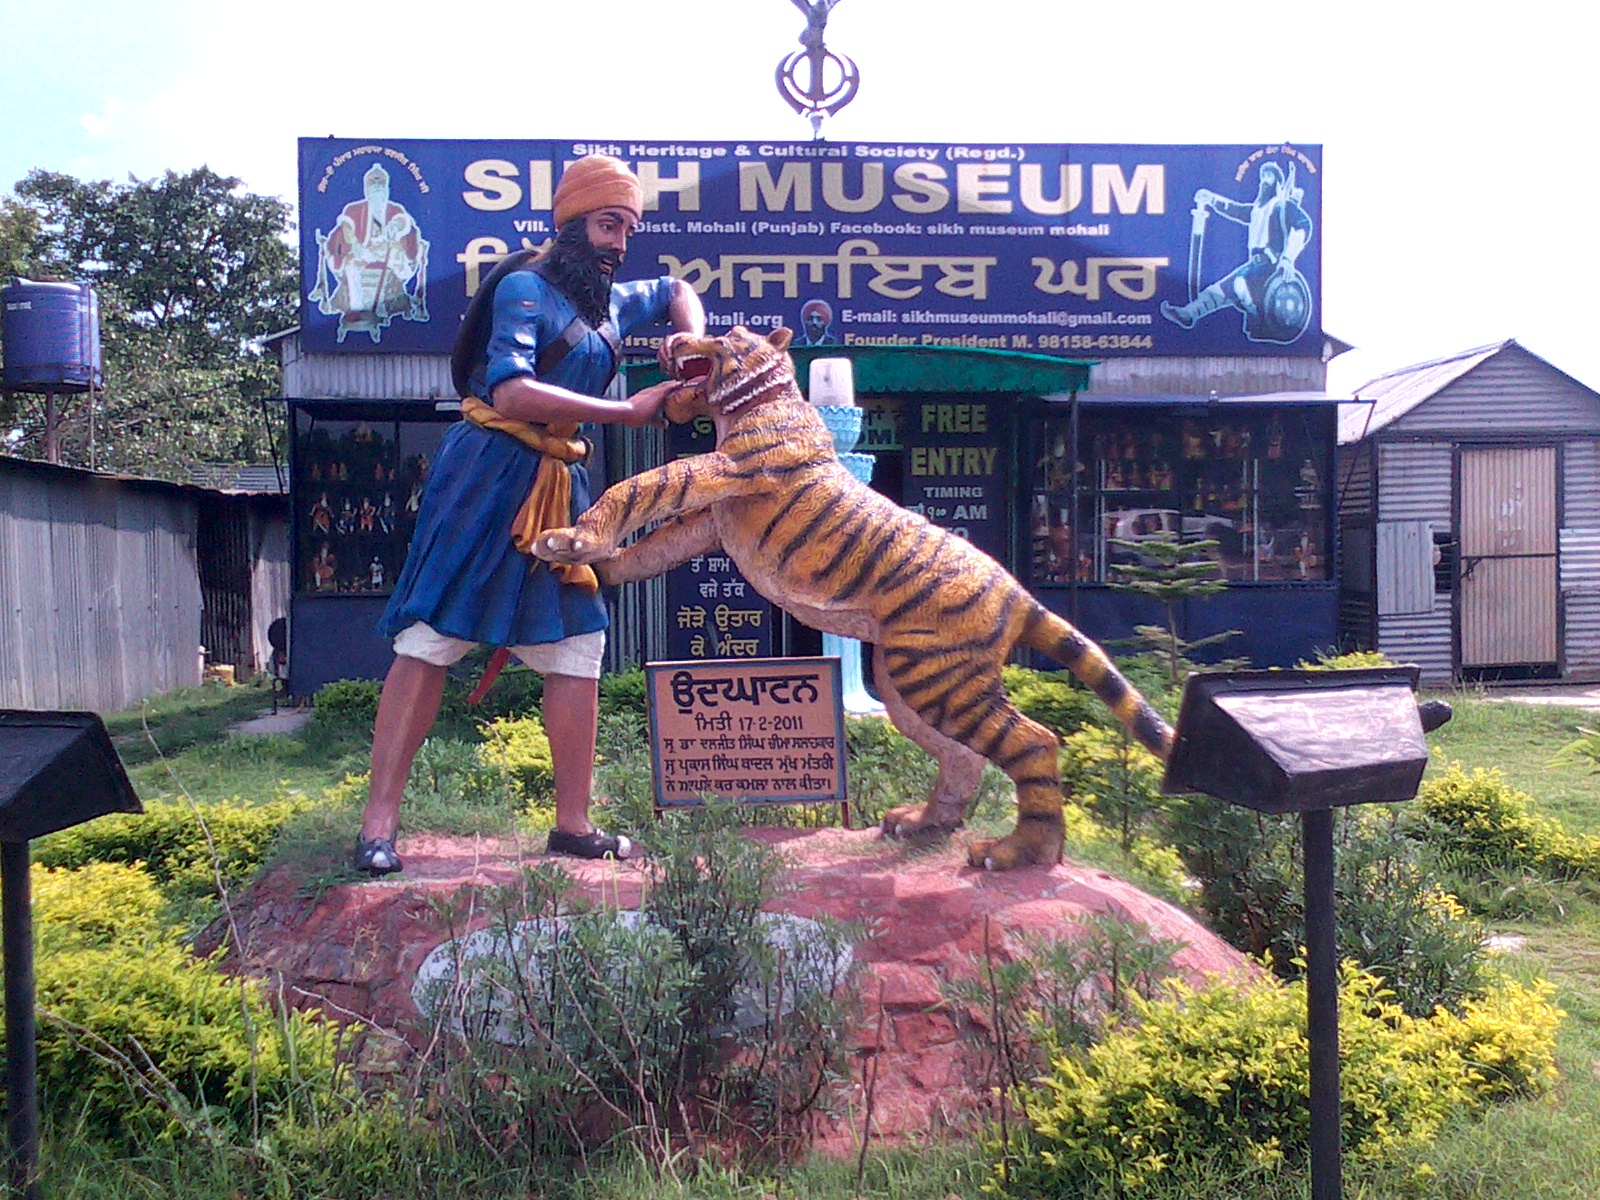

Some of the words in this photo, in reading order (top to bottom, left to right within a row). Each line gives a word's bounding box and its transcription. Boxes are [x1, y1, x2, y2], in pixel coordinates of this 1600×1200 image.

[572, 143, 622, 156] Sikh
[629, 144, 727, 159] Heritage
[734, 145, 751, 156] &
[758, 145, 848, 157] Cultural
[855, 146, 940, 159] Society
[945, 146, 1026, 160] (Regd.)
[463, 159, 700, 212] SIH
[738, 161, 1165, 215] MUSEUM
[513, 220, 549, 233] Vill.
[636, 222, 682, 234] Distt.
[687, 222, 747, 234] Mohali
[751, 222, 825, 236] (Punjab)
[831, 222, 922, 235] Facebook:
[927, 223, 964, 235] sikh
[970, 226, 1044, 236] museum
[1050, 224, 1110, 236] mohali
[1031, 257, 1170, 301] ਘਰ
[842, 309, 897, 323] E-mail:
[901, 310, 1152, 328] sikhmuseummohali@gmail.com
[844, 333, 917, 346] Founder
[921, 334, 1007, 349] President
[1012, 335, 1034, 349] M.
[1038, 335, 1153, 349] 98158-63844
[921, 404, 987, 433] FREE
[910, 447, 998, 476] ENTRY
[923, 486, 983, 498] TIMING
[952, 505, 989, 520] AM
[714, 604, 763, 632] ਉਤਾਰ
[690, 634, 705, 657] ਕੇ
[717, 633, 760, 656] ਅੰਦਰ
[670, 671, 820, 714] ਉਦਘਾਟਨ
[694, 710, 733, 732] ਮਿਤੀ
[738, 733, 766, 750] ਸਿੰਘ
[711, 753, 740, 771] ਸਿੰਘ
[665, 775, 676, 792] ਨੇ
[771, 778, 797, 791] ਨਾਲ
